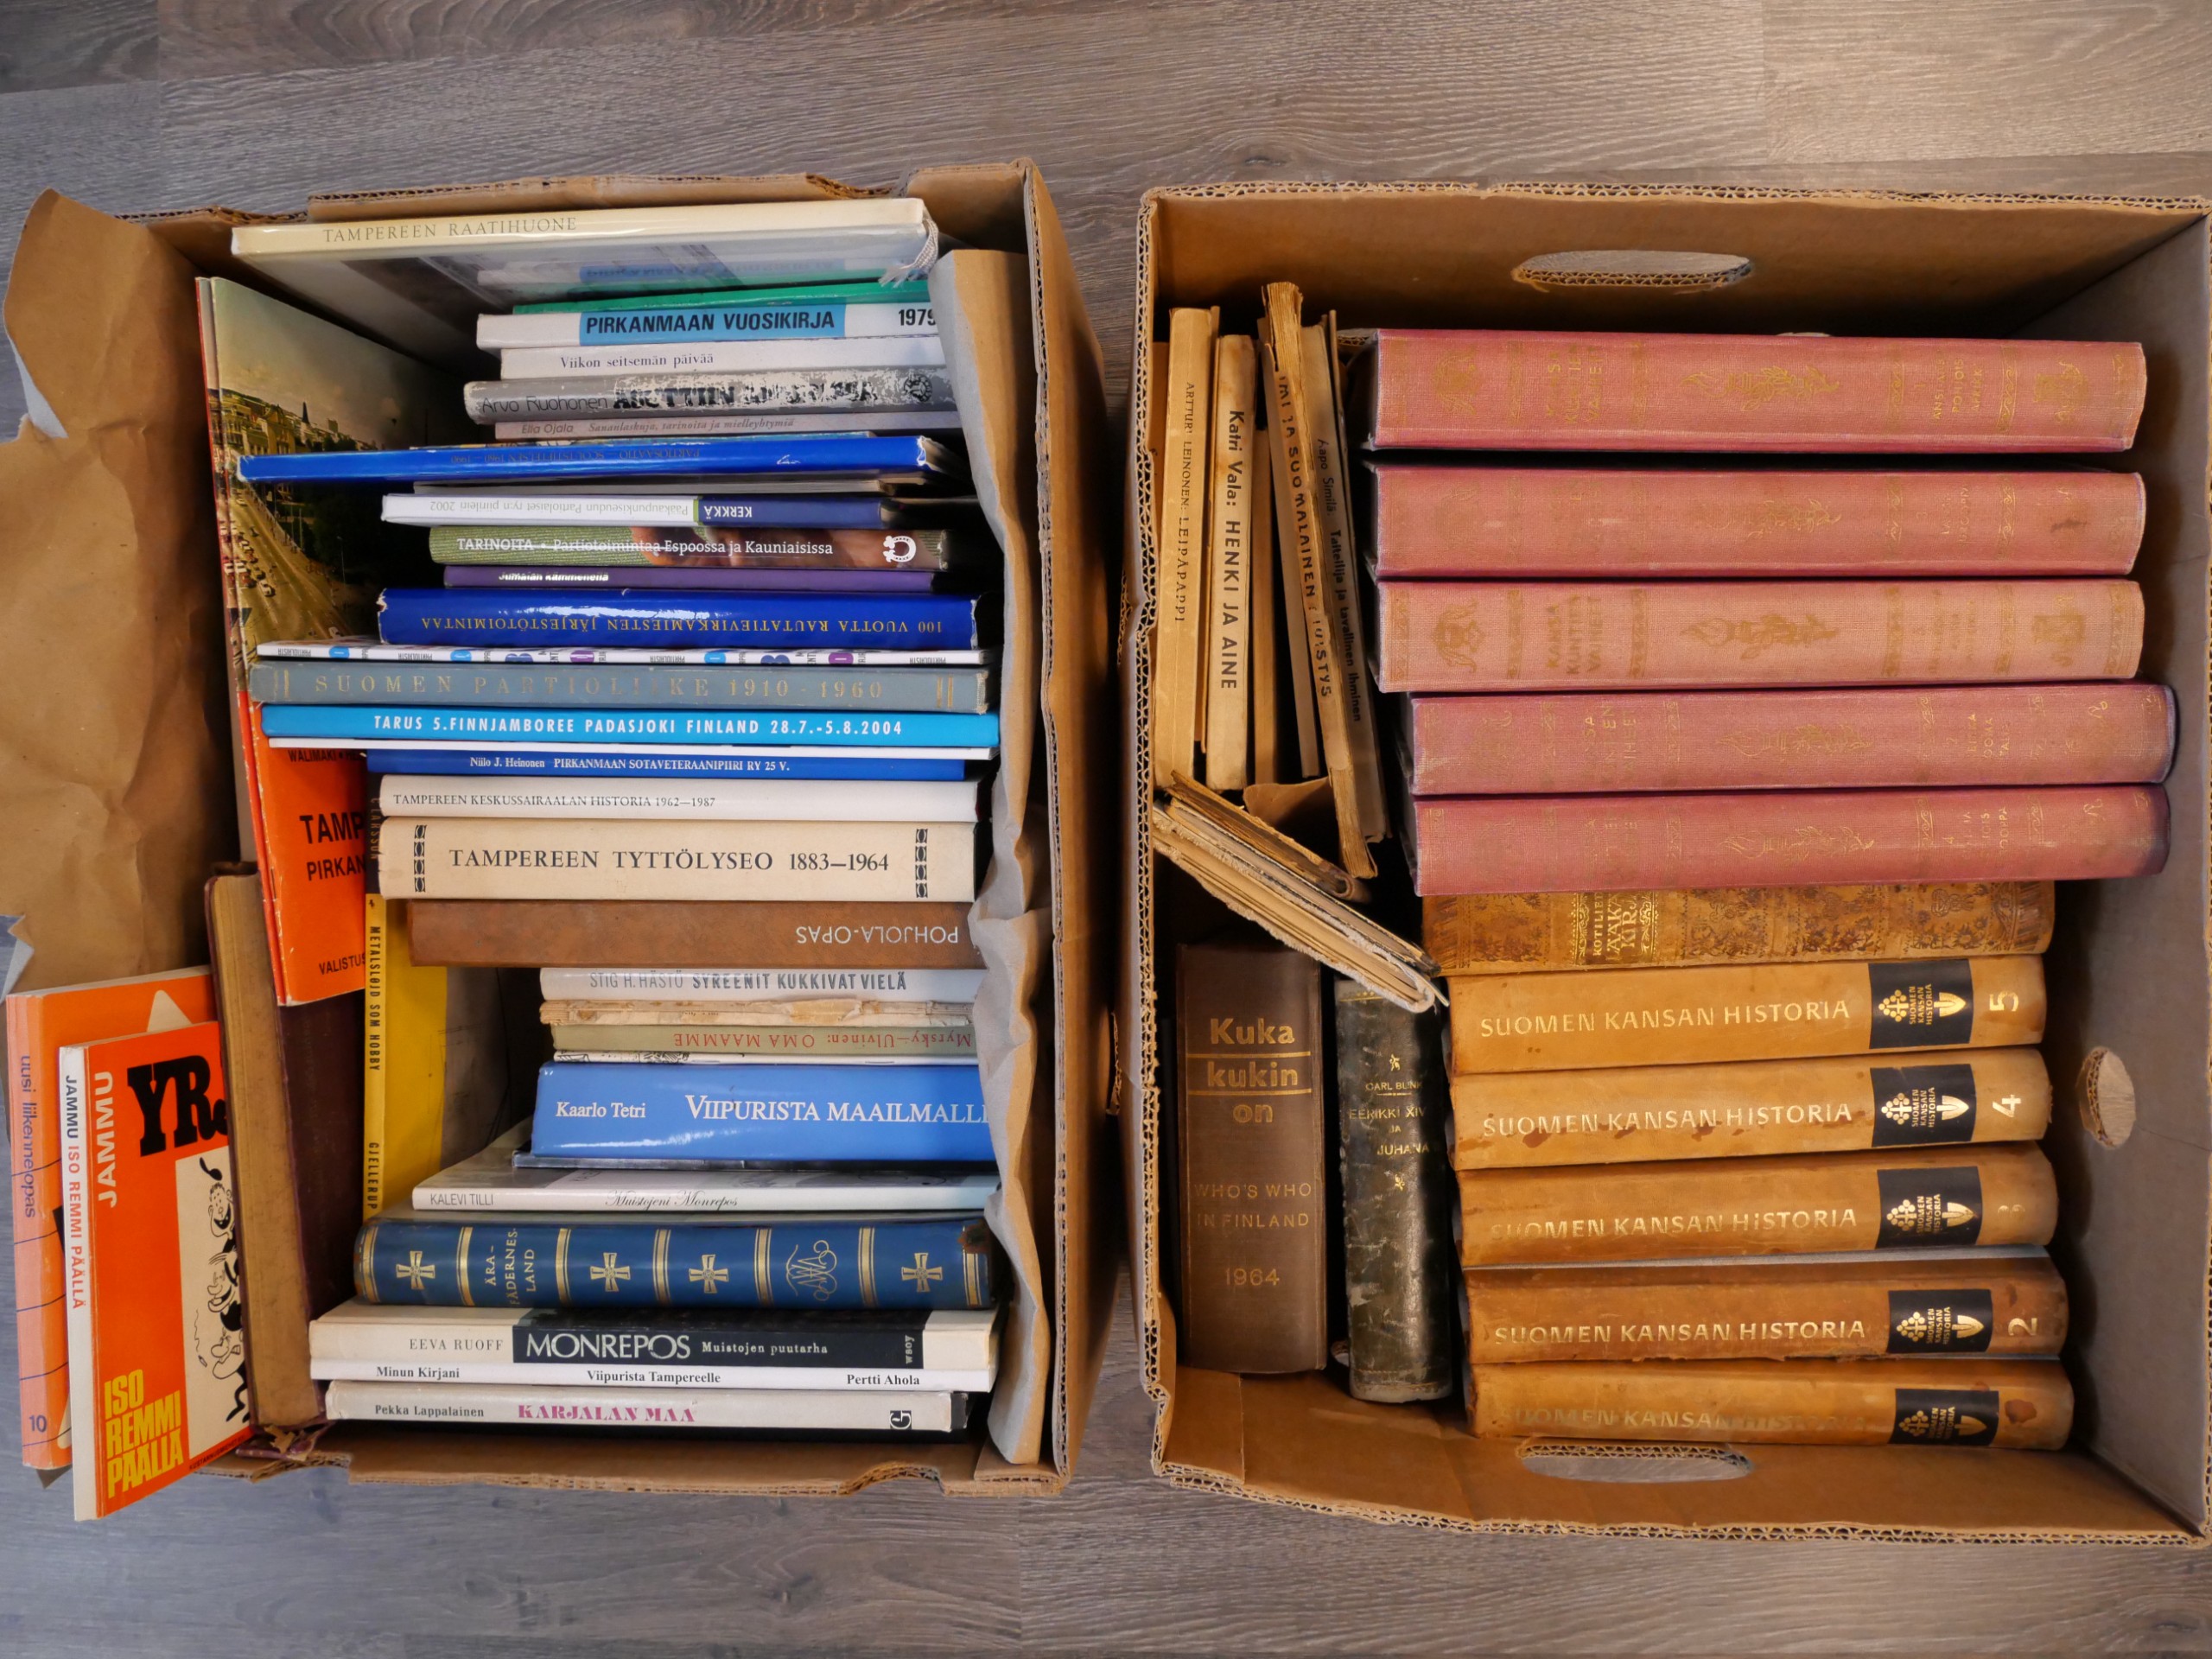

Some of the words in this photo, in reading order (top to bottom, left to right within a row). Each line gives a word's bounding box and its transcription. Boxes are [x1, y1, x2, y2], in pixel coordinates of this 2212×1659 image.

[323, 223, 436, 244] TAMPEREEN
[449, 217, 577, 238] RAATIHUONE
[586, 313, 715, 334] PIRKANMAAN
[723, 311, 835, 330] VUOSIKIRJA
[898, 308, 937, 327] 1979
[561, 356, 601, 370] Viikon
[607, 354, 667, 368] seitsemän
[673, 353, 714, 369] päivää
[482, 397, 519, 414] Arvo
[526, 394, 607, 413] Ruohonen
[543, 423, 574, 435] Ojala
[662, 420, 707, 430] tarinoita
[709, 420, 721, 430] ja
[1228, 410, 1245, 452] Katri
[1318, 438, 1330, 470] Aapo
[1226, 461, 1243, 506] Vala:
[430, 500, 455, 512] 2002
[460, 499, 501, 513] piirileiri
[504, 500, 523, 513] ry:n
[527, 500, 582, 513] Partiolaiset
[587, 501, 689, 516] Pääkaupunkiseudun
[704, 505, 753, 519] KERKKÄ
[1288, 446, 1317, 597] SUOMALAINEN
[457, 537, 534, 551] TARINOITA
[553, 538, 660, 554] Partiotoimintaa
[664, 539, 726, 556] Espoossa
[728, 540, 741, 556] ja
[745, 540, 834, 556] Kauniaisissa
[1223, 520, 1241, 591] HENKI
[1331, 530, 1345, 584] Taiteilija
[1175, 517, 1190, 622] LEIPÄPAPPI
[1335, 588, 1347, 601] ja
[422, 616, 596, 632] JÄRJESTÖTOIMINTAA
[607, 619, 828, 632] RAUTATIEVIRKAMIESTEN
[839, 620, 908, 632] VUOTTA
[1223, 603, 1238, 626] JA
[918, 620, 943, 633] 100
[1339, 607, 1355, 667] tavallinen
[1221, 637, 1236, 689] AINE
[315, 674, 454, 693] SUOMEN
[728, 677, 789, 697] 1910
[820, 679, 883, 699] 1960
[374, 714, 423, 731] TARUS
[433, 715, 575, 734] 5.FINNJAMBOREE
[585, 718, 676, 734] PADASJOKI
[686, 719, 760, 734] FINLAND
[770, 719, 903, 736] 28.7.-5.8.2004
[470, 756, 492, 767] Niilo
[494, 756, 503, 767] J.
[505, 756, 545, 768] Heinonen
[553, 757, 626, 770] PIRKANMAAN
[629, 759, 744, 771] SOTAVETERAANIPIIRI
[747, 760, 761, 772] RY
[765, 760, 777, 772] 25
[779, 761, 790, 772] V.
[393, 794, 467, 806] TAMPEREEN
[470, 794, 588, 807] KESKUSSAIRAALAN
[590, 796, 652, 807] HISTORIA
[307, 856, 366, 882] PIRKAN
[449, 849, 599, 868] TAMPEREEN
[612, 848, 773, 871] TYTTÖLYSEO
[796, 925, 960, 944] POHJOLA-OPAS
[369, 926, 381, 997] METALSLØJD
[589, 971, 620, 988] STIG
[624, 972, 637, 988] H.
[692, 972, 770, 989] SYREENIT
[778, 972, 855, 990] KUKKIVAT
[861, 971, 907, 990] VIELÄ
[1989, 991, 2019, 1013] 5
[369, 1004, 381, 1027] SOM
[1481, 1012, 1594, 1038] SUOMEN
[1605, 1007, 1714, 1030] KANSAN
[1724, 1000, 1850, 1025] HISTORIA
[674, 1033, 760, 1047] MAAMME
[769, 1033, 814, 1047] OMA
[1210, 1018, 1295, 1046] Kuka
[369, 1034, 381, 1071] HOBBY
[21, 1054, 36, 1094] uusi
[1207, 1061, 1299, 1087] kukin
[1365, 1083, 1393, 1092] CARL
[66, 1075, 79, 1139] JAMMU
[556, 1102, 607, 1118] Kaarlo
[610, 1102, 646, 1119] Tetri
[1233, 1103, 1274, 1123] on
[1992, 1094, 2022, 1118] 4
[1483, 1113, 1599, 1137] SUOMEN
[1608, 1108, 1717, 1132] KANSAN
[1726, 1103, 1853, 1127] HISTORIA
[94, 1071, 118, 1208] JAMMU
[1377, 1142, 1430, 1155] JUHANA
[22, 1101, 39, 1219] liikenneopas
[68, 1145, 81, 1173] ISO
[367, 1142, 379, 1211] GJELLERUP
[430, 1193, 467, 1206] KALEVI
[469, 1193, 493, 1206] TILLI
[605, 1189, 671, 1211] Muistojeni
[674, 1189, 738, 1211] Monrepos
[1193, 1183, 1258, 1199] WHO'S
[1265, 1182, 1312, 1198] WHO
[69, 1181, 83, 1238] REMMI
[1197, 1213, 1215, 1227] IN
[1221, 1212, 1310, 1228] FINLAND
[1490, 1218, 1605, 1241] SUOMEN
[1613, 1213, 1724, 1236] KANSAN
[1732, 1208, 1857, 1232] HISTORIA
[71, 1245, 87, 1309] PÄÄLLÄ
[525, 1249, 536, 1293] LAND
[1225, 1268, 1280, 1287] 1964
[1494, 1325, 1611, 1345] SUOMEN
[1620, 1323, 1731, 1343] KANSAN
[1739, 1319, 1866, 1341] HISTORIA
[2007, 1318, 2037, 1337] 2
[410, 1338, 447, 1351] EEVA
[454, 1338, 505, 1351] RUOFF
[526, 1332, 691, 1359] MONREPOS
[702, 1341, 765, 1356] Muistojen
[770, 1343, 828, 1356] puutarha
[376, 1365, 415, 1379] Minun
[417, 1366, 460, 1381] Kirjani
[587, 1369, 645, 1384] Viipurista
[649, 1370, 721, 1385] Tampereelle
[846, 1373, 880, 1386] Pertti
[883, 1374, 920, 1386] Ahola
[104, 1368, 144, 1421] ISO
[29, 1414, 47, 1433] 10
[105, 1389, 182, 1460] REMMI
[375, 1403, 410, 1417] Pekka
[414, 1404, 484, 1420] Lappalainen
[518, 1403, 639, 1423] KARJALAN
[644, 1407, 696, 1423] MAA
[1624, 1410, 1732, 1431] KANSAN
[106, 1427, 184, 1500] PÄÄLLÄ
